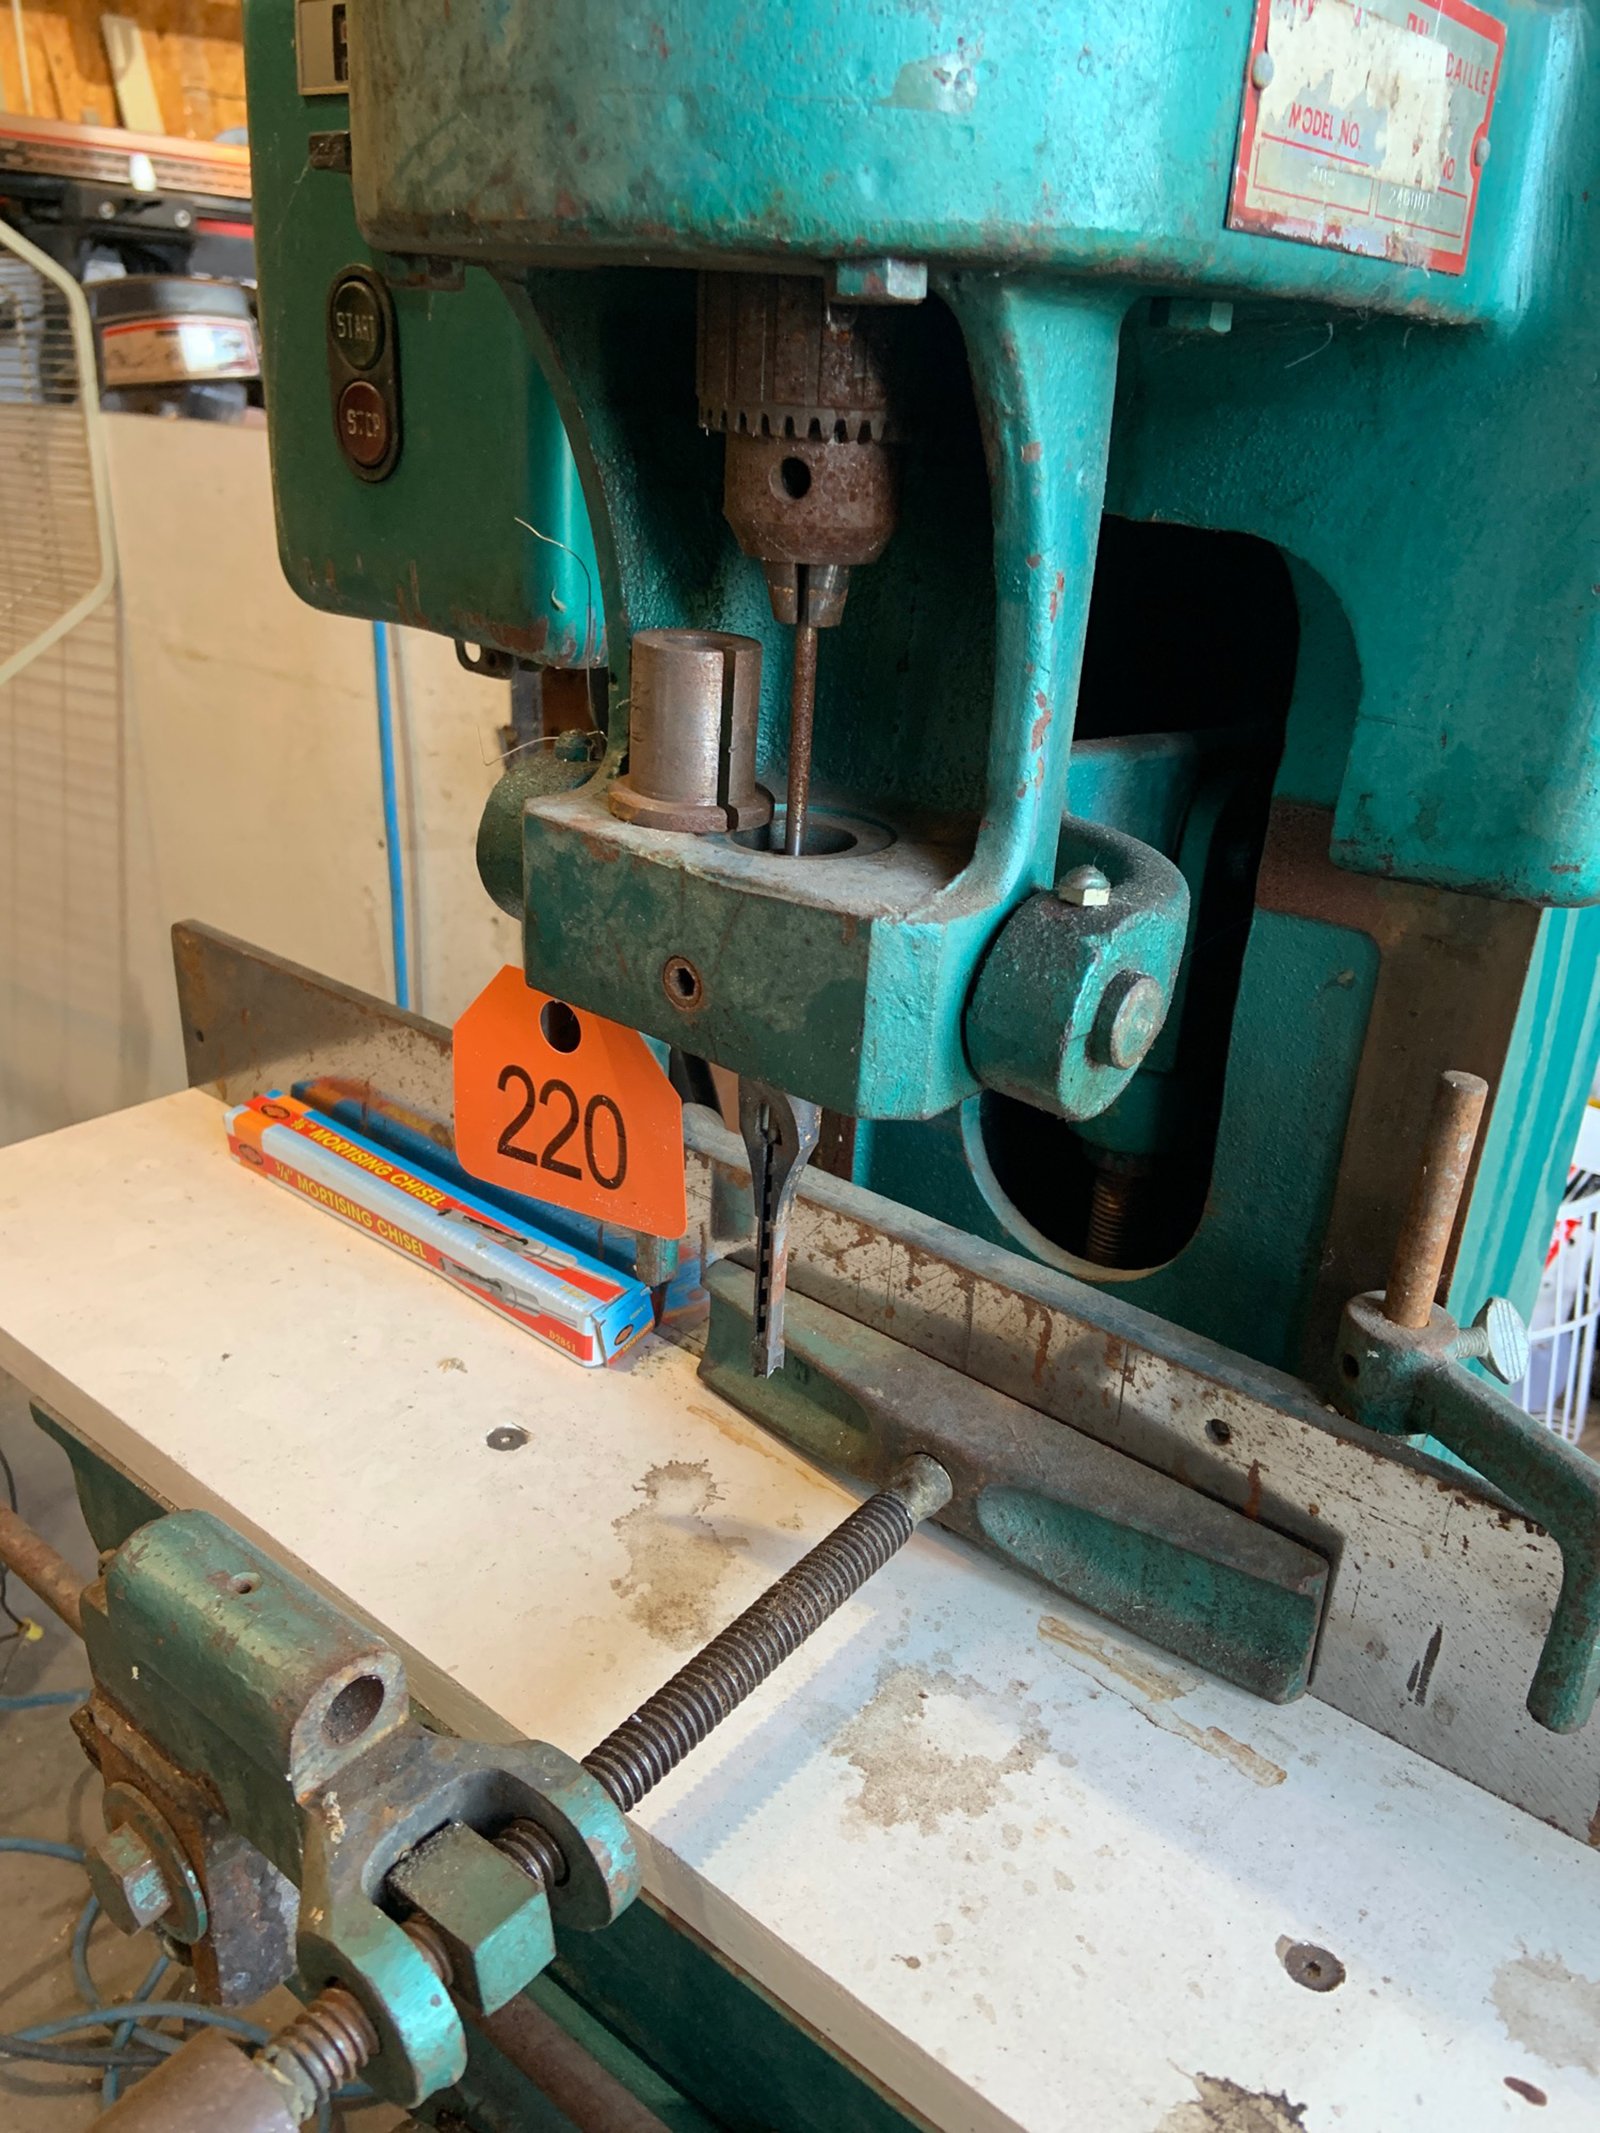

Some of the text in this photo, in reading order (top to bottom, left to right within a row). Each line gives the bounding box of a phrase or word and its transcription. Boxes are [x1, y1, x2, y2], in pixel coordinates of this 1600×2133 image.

[1288, 101, 1334, 142] MODEL
[336, 311, 375, 341] START
[346, 408, 380, 438] STOP
[497, 1064, 628, 1190] 220
[309, 1128, 393, 1177] MORTISING
[390, 1173, 447, 1207] CHISEL
[297, 1174, 373, 1228] MORTISING
[377, 1219, 428, 1260] CHISEL
